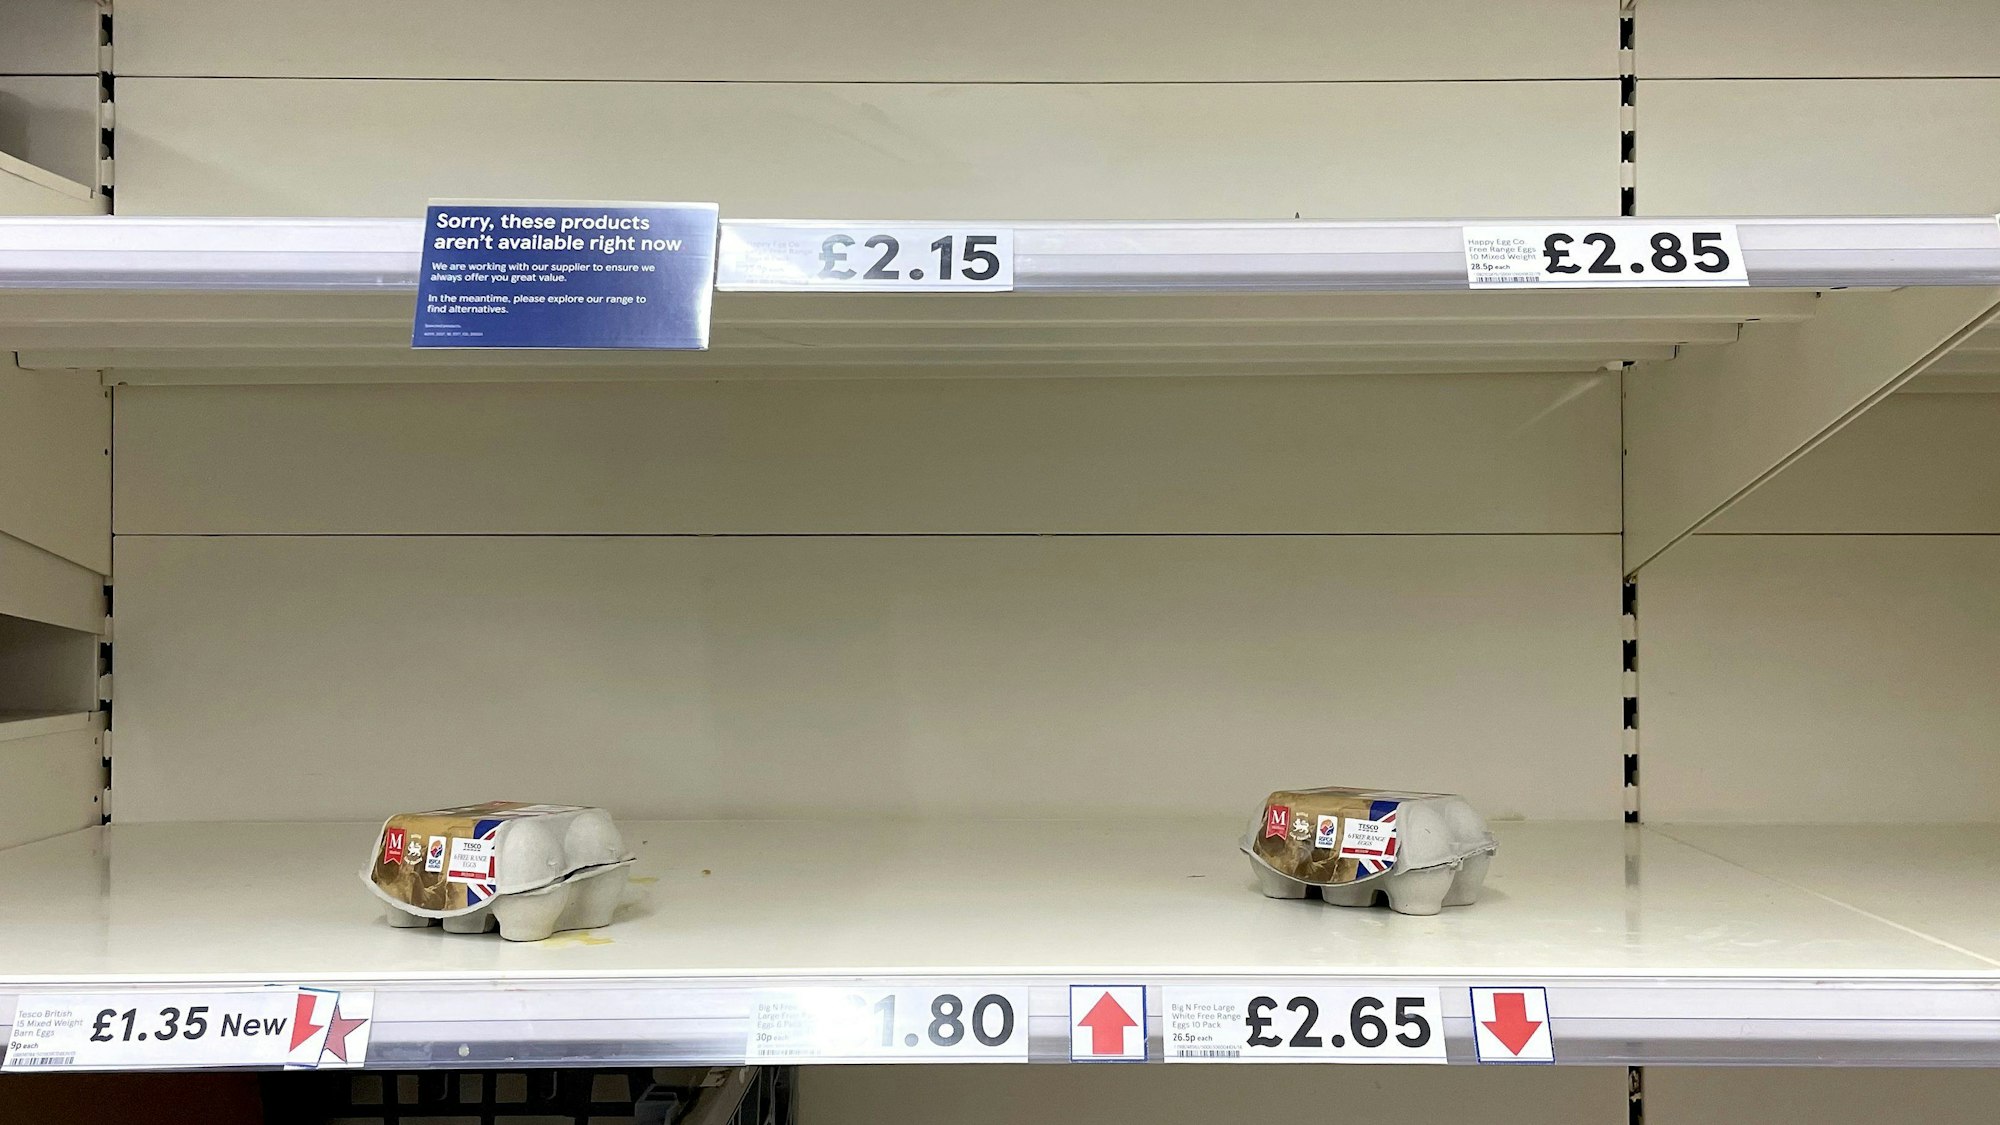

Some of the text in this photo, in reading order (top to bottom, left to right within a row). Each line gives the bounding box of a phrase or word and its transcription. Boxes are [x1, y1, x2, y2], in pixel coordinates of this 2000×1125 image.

[436, 213, 650, 234] Sorry, these products
[434, 234, 682, 254] aren't available right now
[1468, 239, 1494, 247] Happy
[817, 234, 1000, 280] £2.15
[1507, 253, 1536, 261] Weight
[1543, 232, 1730, 274] £2.85
[432, 262, 448, 271] We
[468, 262, 506, 272] working
[508, 262, 530, 271] with
[532, 264, 549, 272] our
[551, 263, 590, 274] supplier
[593, 264, 603, 272] to
[1471, 263, 1494, 271] 28.5p
[431, 273, 567, 283] always offer you great value.
[428, 294, 437, 302] In
[439, 294, 457, 303] the
[459, 294, 511, 304] meantime,
[513, 295, 545, 305] please
[548, 295, 584, 305] explore
[606, 297, 633, 305] range
[636, 296, 646, 304] to
[427, 305, 508, 314] find alternatives.
[1271, 810, 1286, 825] M
[389, 833, 403, 849] M
[759, 1004, 771, 1012] Big
[1172, 1004, 1184, 1012] Big
[1213, 1004, 1235, 1012] Large
[19, 1010, 72, 1018] Tesco British
[1217, 1013, 1241, 1021] Range
[27, 1019, 52, 1027] Mixed
[54, 1019, 83, 1028] Weight
[90, 1006, 288, 1042] £1.35 New
[843, 994, 1014, 1046] 1.80
[1246, 996, 1431, 1048] £2.65
[1172, 1021, 1190, 1030] Eggs
[36, 1029, 55, 1037] Eggs
[756, 1032, 772, 1042] 30p
[1173, 1033, 1196, 1042] 26.5p
[10, 1041, 22, 1051] 9p
